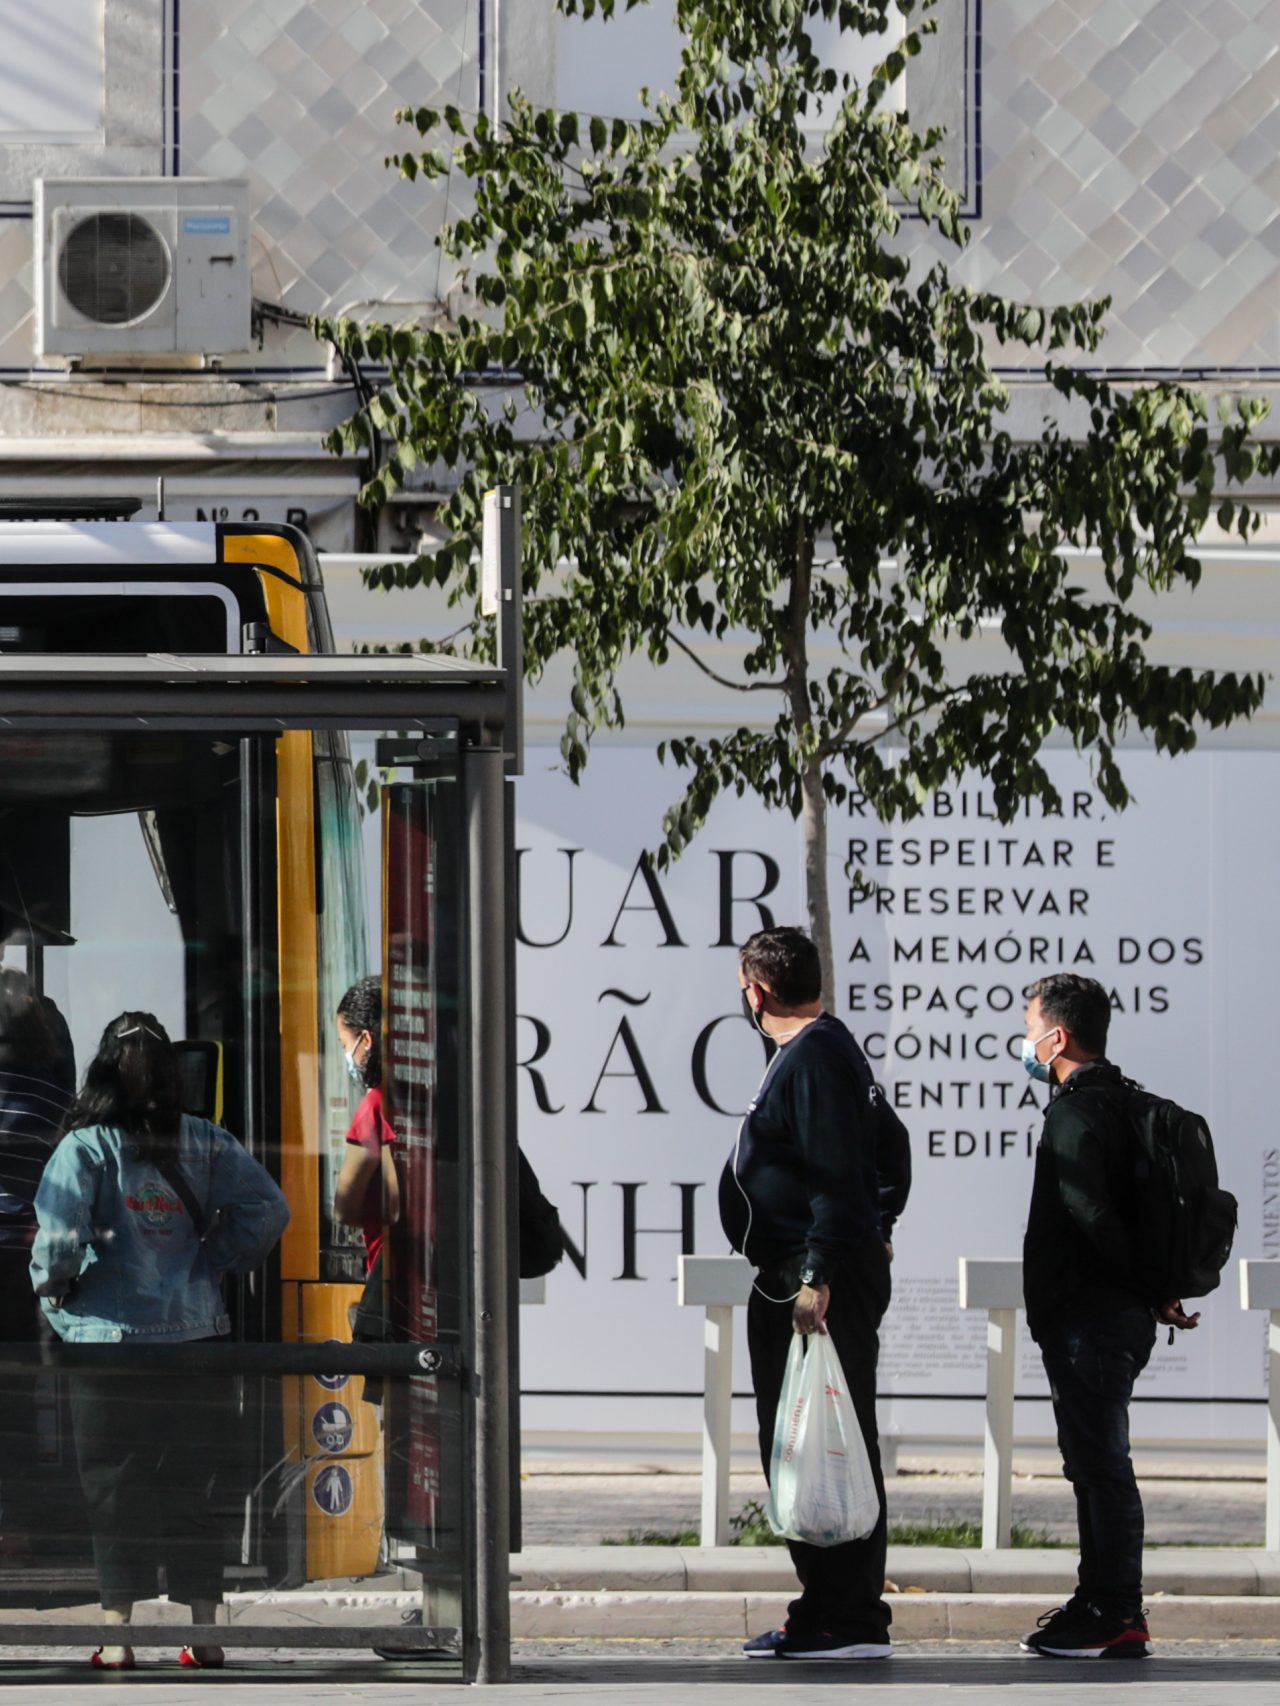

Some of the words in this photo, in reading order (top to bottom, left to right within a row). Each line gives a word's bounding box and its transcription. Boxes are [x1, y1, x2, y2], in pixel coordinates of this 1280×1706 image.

[848, 839, 1074, 867] RESPEITAR
[1097, 840, 1116, 867] E
[848, 888, 1090, 916] PRESERVAR
[848, 937, 871, 963] A
[893, 929, 1095, 963] MEMÓRIA
[1120, 937, 1204, 965] DOS
[852, 1025, 1027, 1060] CÓNICO
[928, 1123, 1035, 1158] EDIFÍ
